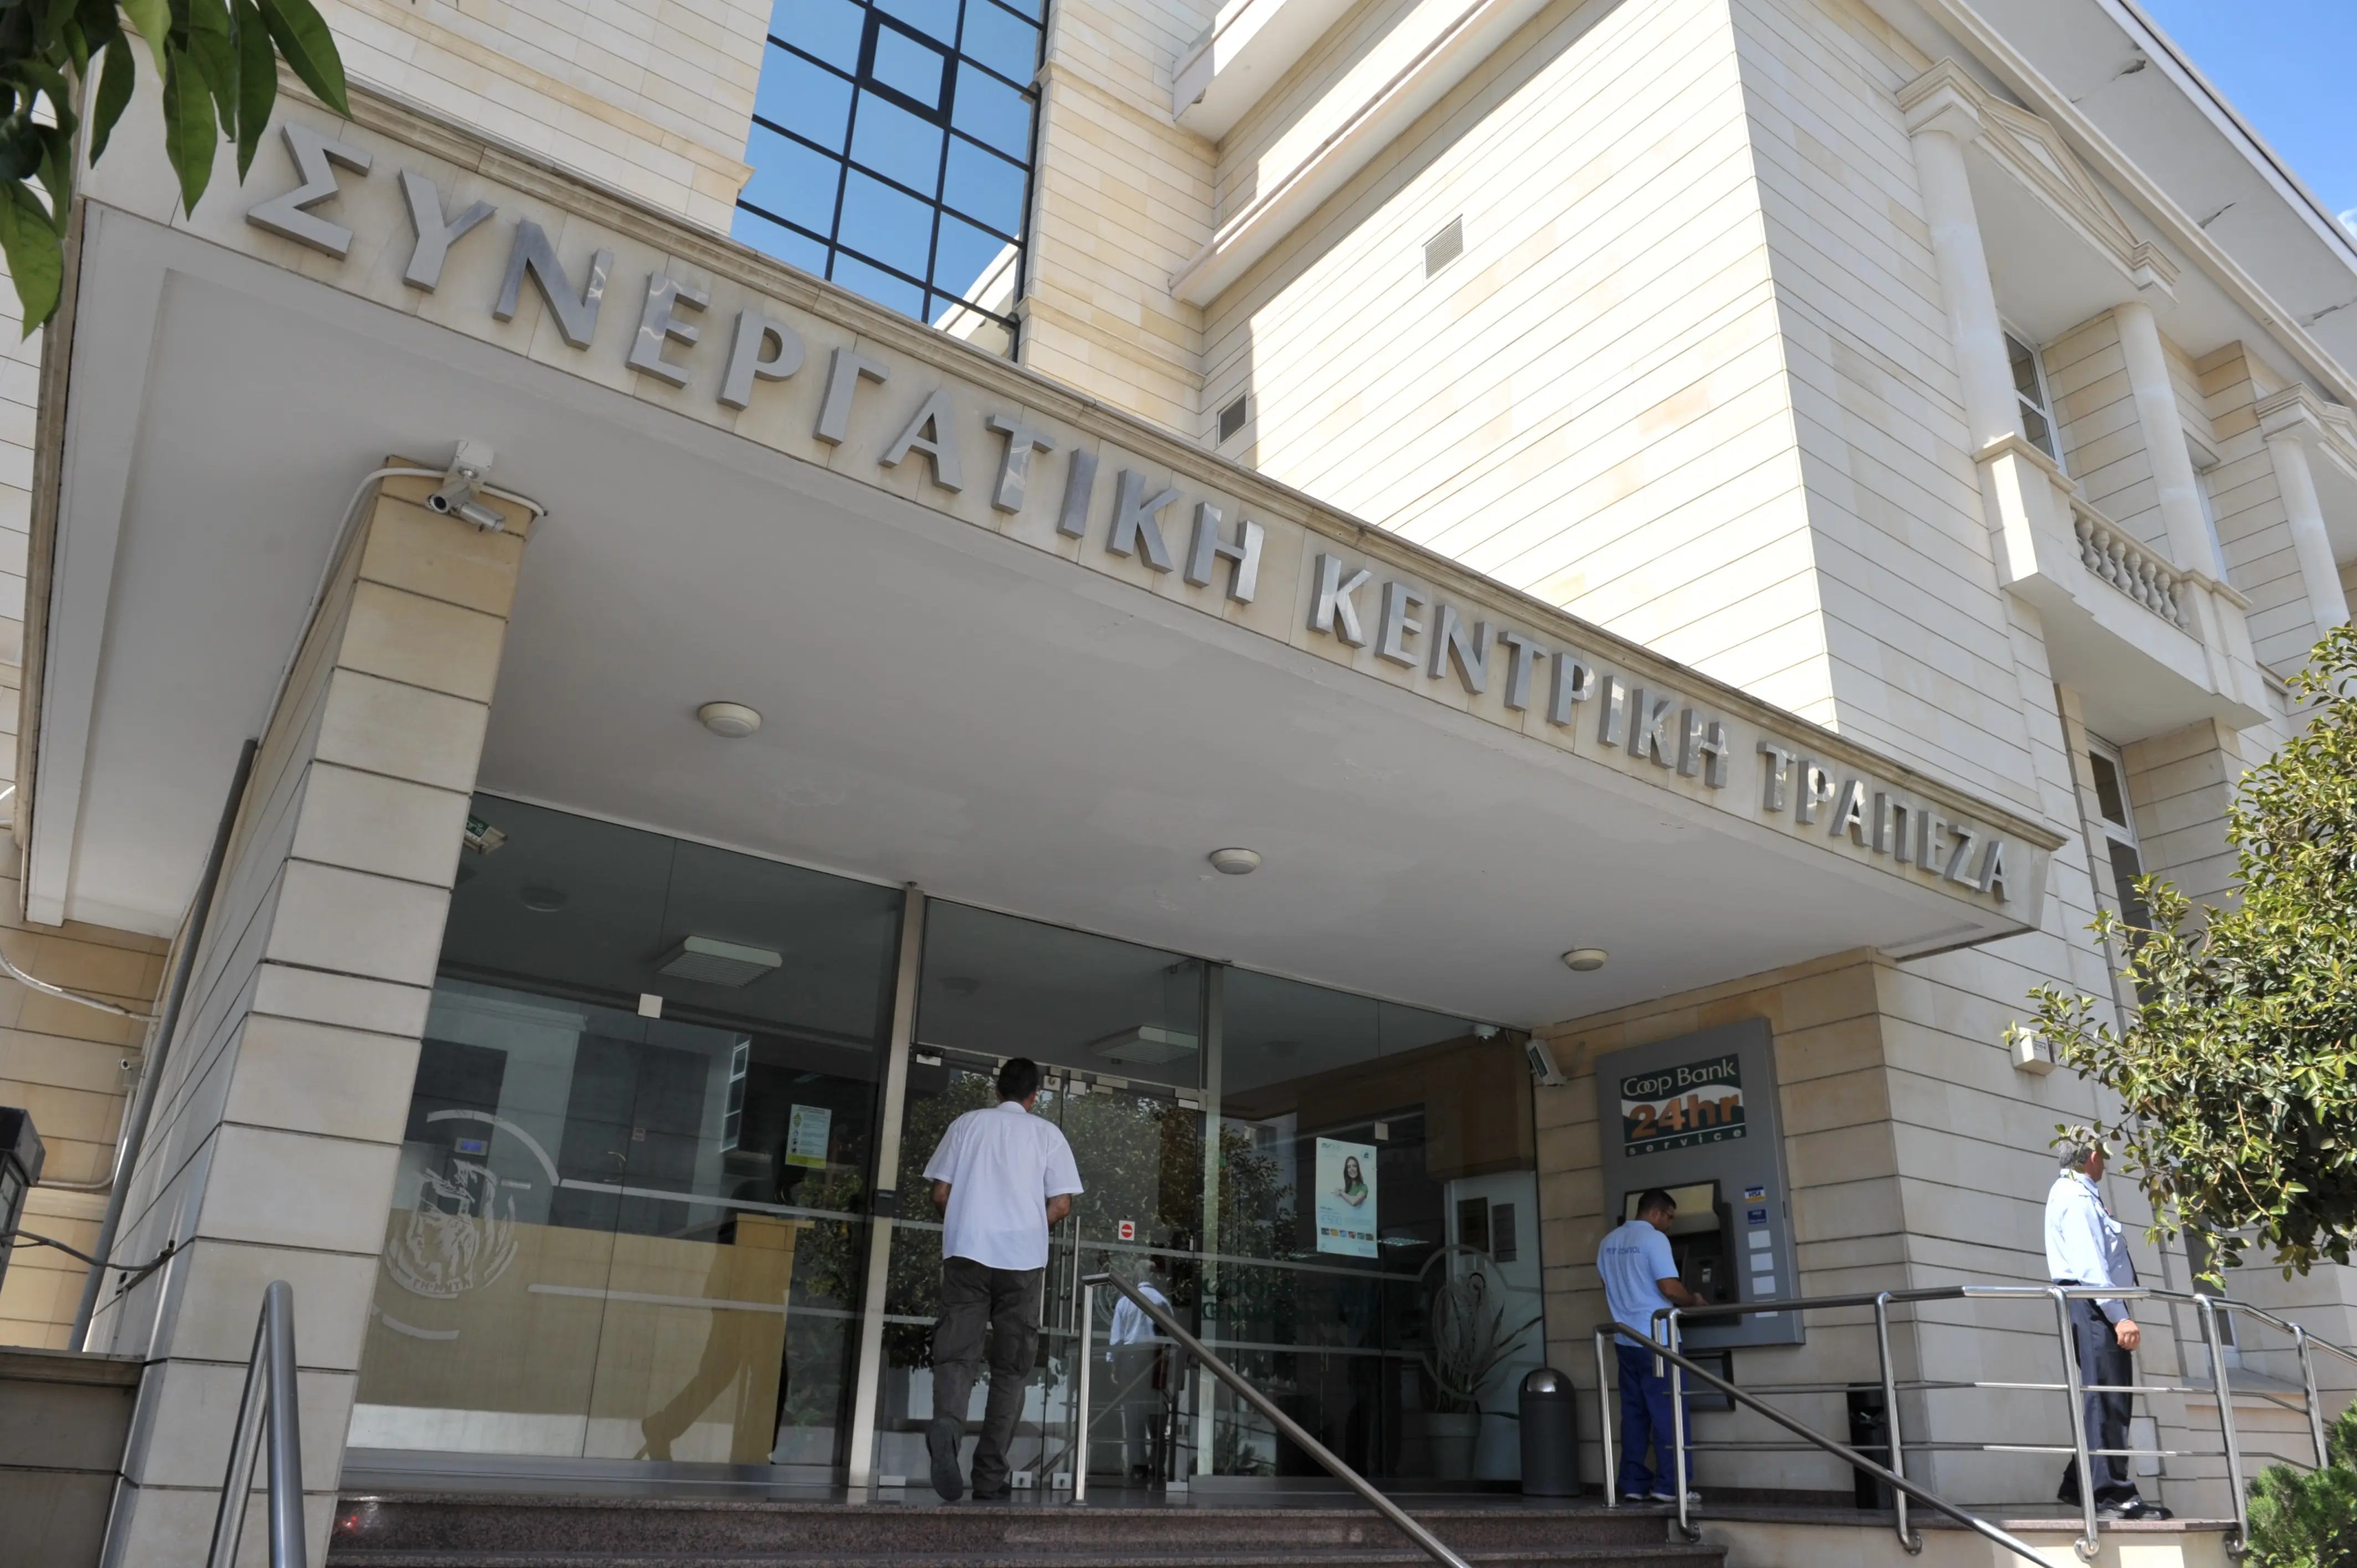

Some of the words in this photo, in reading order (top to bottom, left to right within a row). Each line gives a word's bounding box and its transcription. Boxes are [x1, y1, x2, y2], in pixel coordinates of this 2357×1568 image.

[246, 119, 1265, 606] ΣΥΝΕΡΓΑΤΙΚΗ
[1306, 553, 1728, 789] ΚΕΝΤΡΙΚΗ
[1757, 741, 2011, 902] ΤΡΑΠΕΖΑ
[1623, 1076, 1672, 1096] Coop
[1676, 1059, 1736, 1086] Bank
[1629, 1094, 1739, 1139] 24hr
[1629, 1128, 1742, 1156] service
